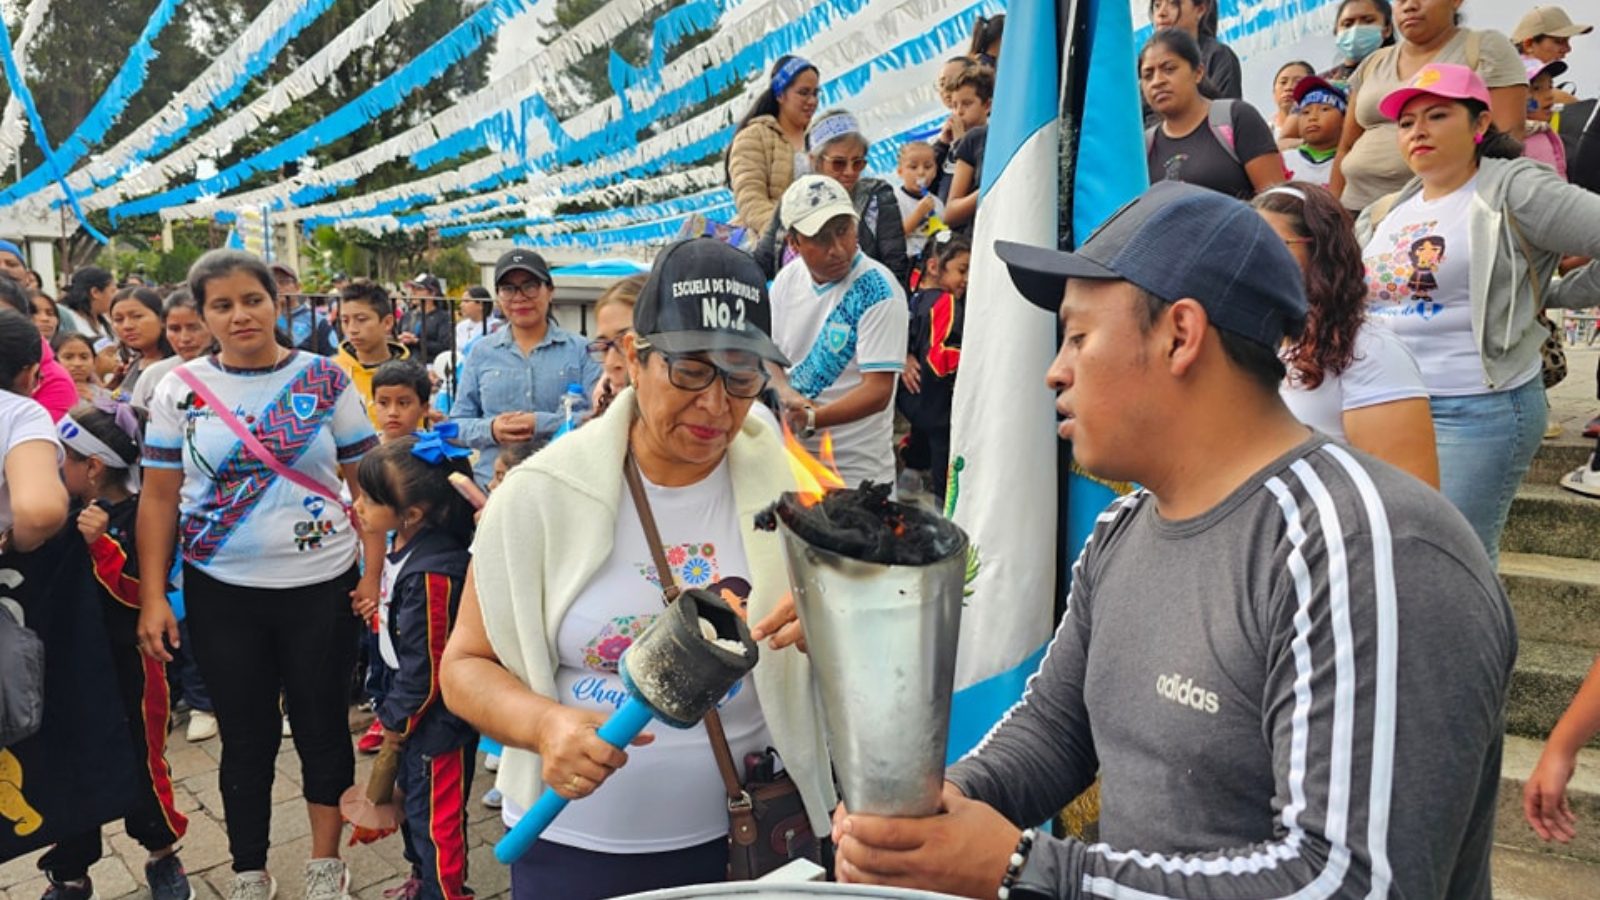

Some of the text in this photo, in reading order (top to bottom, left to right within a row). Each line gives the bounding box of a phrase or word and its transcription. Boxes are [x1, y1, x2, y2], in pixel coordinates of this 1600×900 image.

[672, 278, 711, 298] ESCUELA
[712, 278, 724, 293] DE
[702, 297, 746, 331] No.2
[572, 676, 628, 709] Chap
[1156, 673, 1219, 714] adidas
